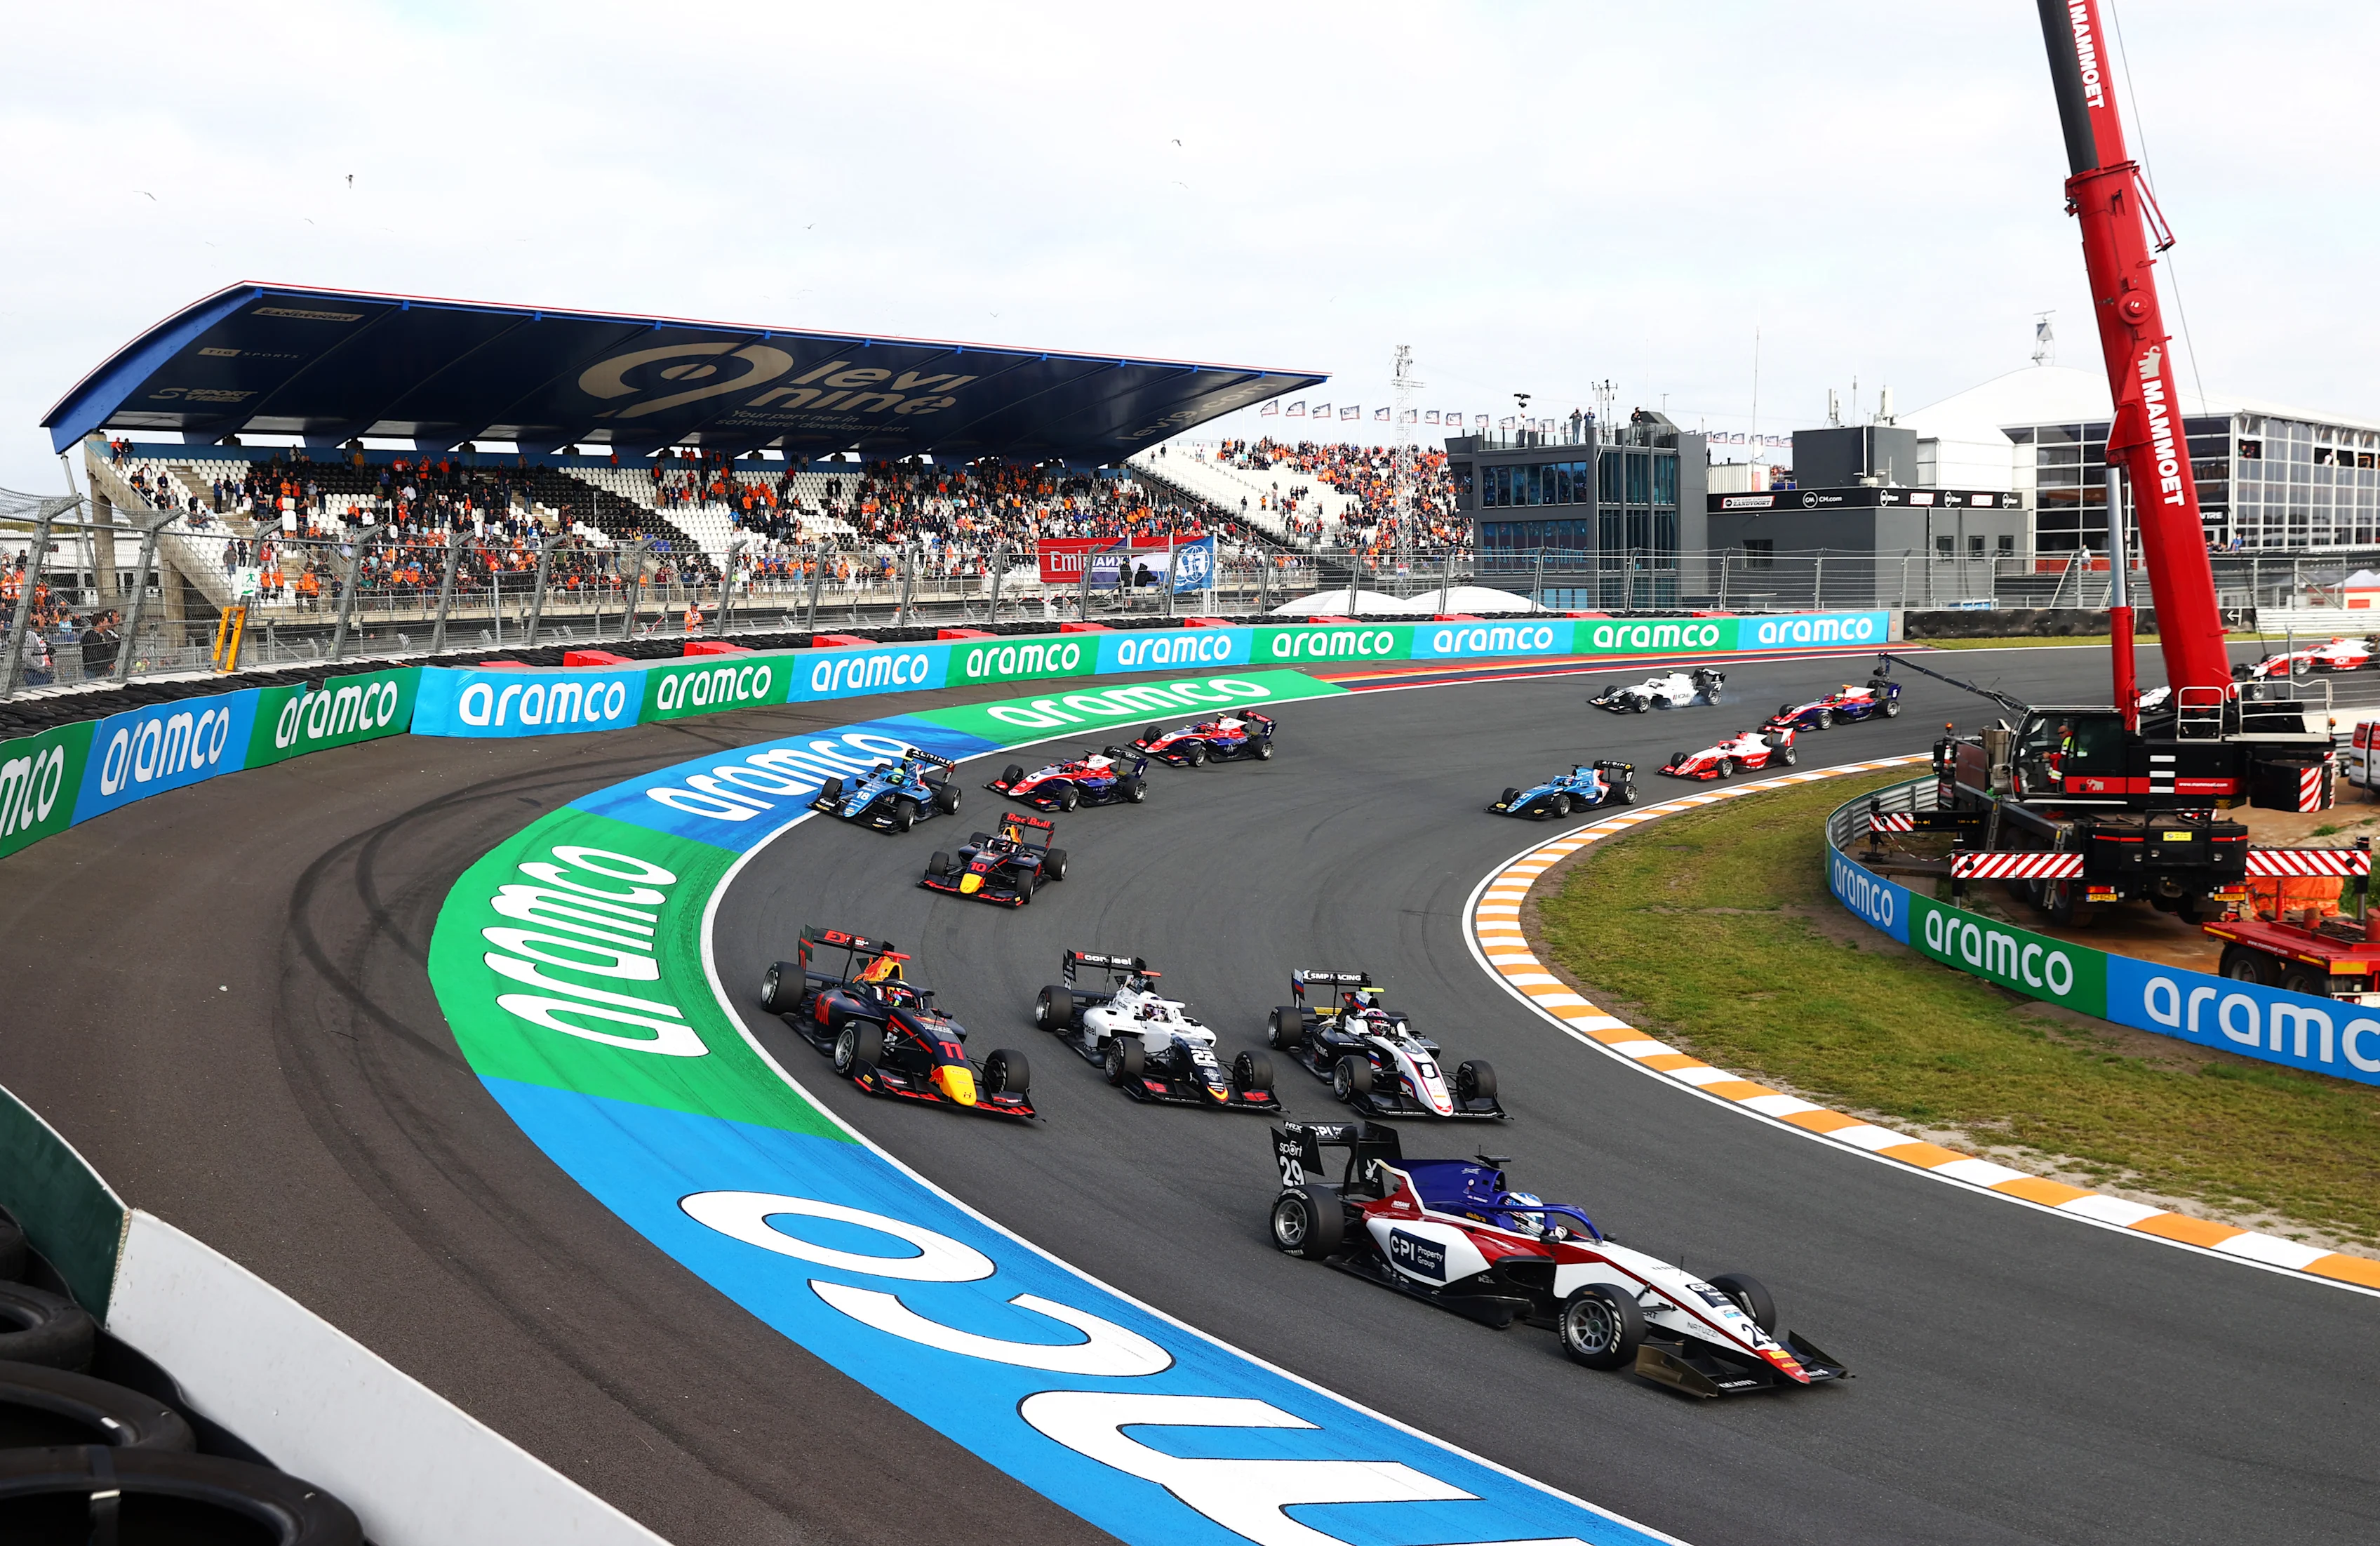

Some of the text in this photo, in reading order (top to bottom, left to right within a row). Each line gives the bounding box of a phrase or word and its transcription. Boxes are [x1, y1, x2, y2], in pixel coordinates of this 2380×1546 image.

[2070, 4, 2105, 108] MAMMOET
[789, 360, 980, 393] levi
[185, 394, 245, 403] VIBES
[187, 389, 259, 397] SPORT
[744, 387, 957, 415] nine
[715, 418, 795, 428] software
[731, 410, 772, 419] Your
[2141, 380, 2185, 506] MAMMOET
[1272, 629, 1394, 657] aramco
[1433, 627, 1553, 653] aramco
[1593, 623, 1720, 648] aramco
[1758, 617, 1873, 644] aramco
[966, 642, 1080, 679] aramco
[1118, 634, 1231, 666] aramco
[811, 653, 929, 692] aramco
[657, 665, 772, 710] aramco
[275, 681, 398, 749] aramco
[459, 681, 625, 726] aramco
[987, 678, 1272, 731] aramco
[1266, 726, 1273, 735] 5
[100, 706, 229, 796] aramco
[646, 733, 915, 821] aramco
[1138, 765, 1144, 775] 4
[1625, 771, 1633, 782] 17
[856, 790, 871, 801] 18
[1028, 816, 1052, 829] Bull
[970, 861, 987, 872] 10
[1834, 858, 1894, 927] aramco
[481, 844, 711, 1058] aramco
[1925, 909, 2074, 997] aramco
[2144, 975, 2380, 1074] aramc
[938, 1041, 965, 1060] 11
[1191, 1049, 1219, 1067] 22
[1421, 1063, 1435, 1078] 8
[1285, 1121, 1304, 1132] HRX
[1280, 1155, 1305, 1187] 29
[1390, 1234, 1444, 1262] CPI Property
[1417, 1255, 1436, 1270] Group
[1610, 1310, 1622, 1354] ZERO
[1687, 1321, 1719, 1338] NATUZZI
